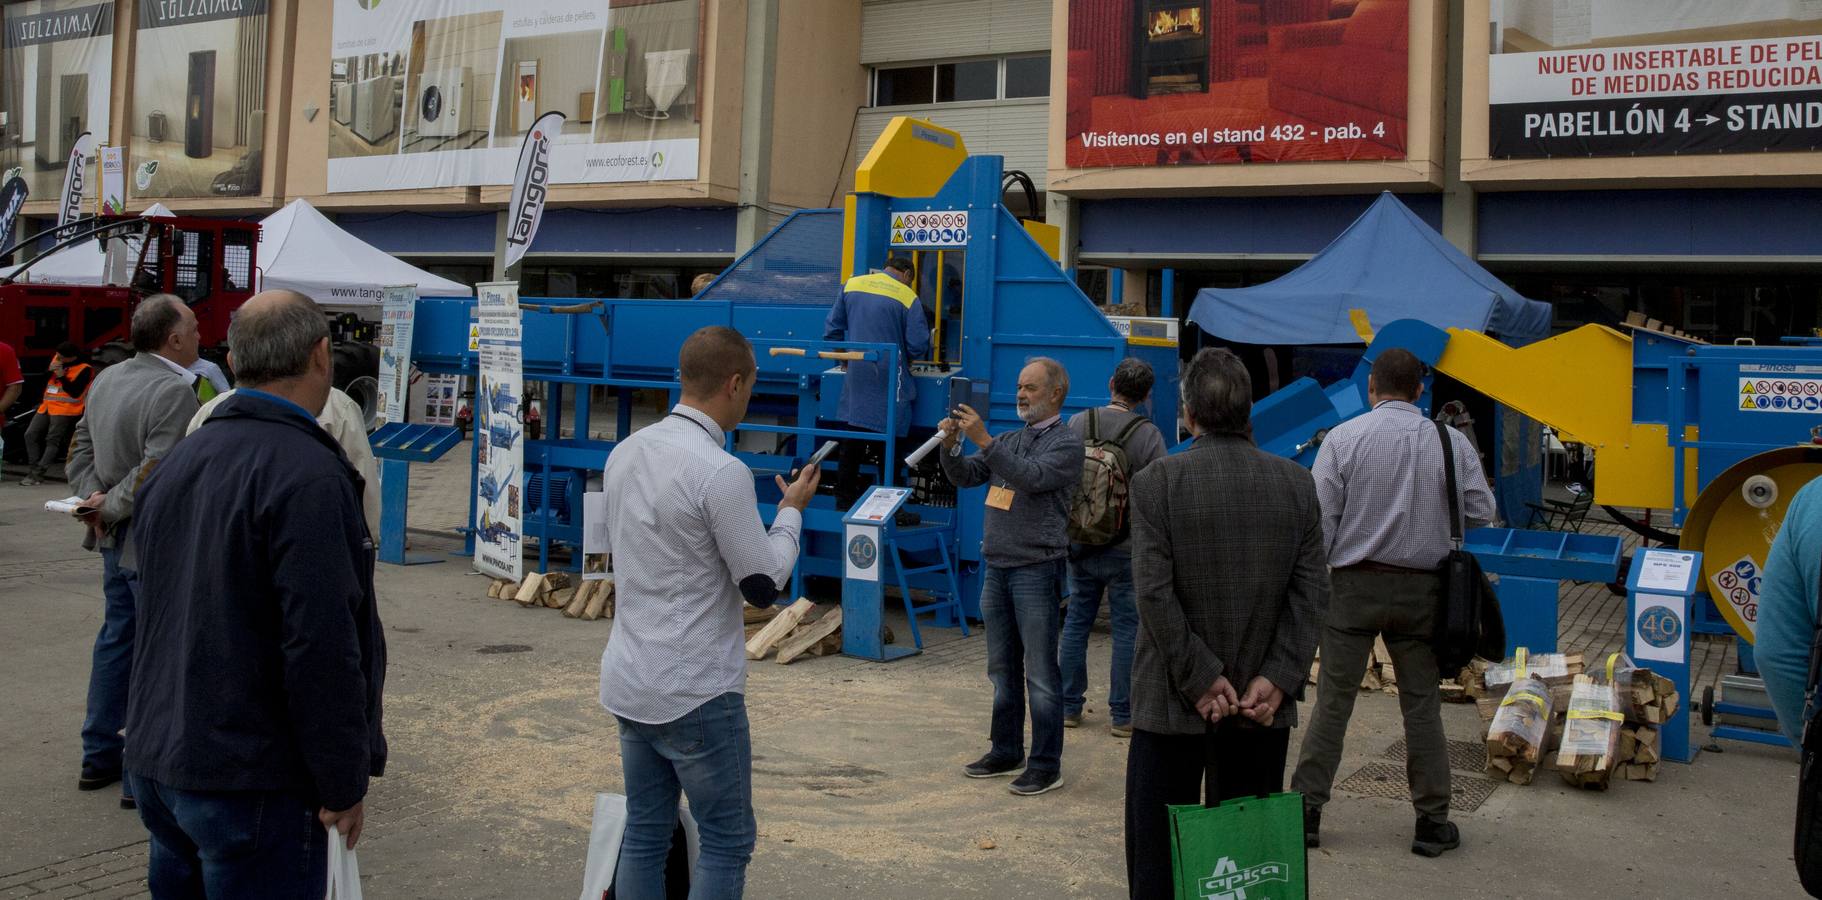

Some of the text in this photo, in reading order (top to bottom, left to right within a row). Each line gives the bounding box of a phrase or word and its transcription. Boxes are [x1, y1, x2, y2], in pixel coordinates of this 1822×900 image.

[21, 13, 91, 40] SOLZAIMA
[1538, 53, 1605, 75] NUEVO
[1613, 46, 1742, 71] INSERTABLE
[1750, 43, 1778, 63] DE
[1571, 66, 1822, 95] DE MEDIDAS REDUCIDA
[1524, 102, 1822, 138] PABELLÓN 4 STAND
[1081, 130, 1160, 148] Visítenos
[1165, 131, 1187, 145] en
[1192, 128, 1208, 144] el
[1213, 125, 1265, 143] stand
[1270, 124, 1305, 141] 432
[1324, 123, 1367, 143] pab.
[1373, 122, 1385, 138] 4
[586, 154, 648, 168] www.ecoforest.es
[1759, 363, 1797, 372] Pinosa
[851, 542, 873, 559] 40
[1642, 614, 1677, 635] 40
[1205, 865, 1279, 890] apisa
